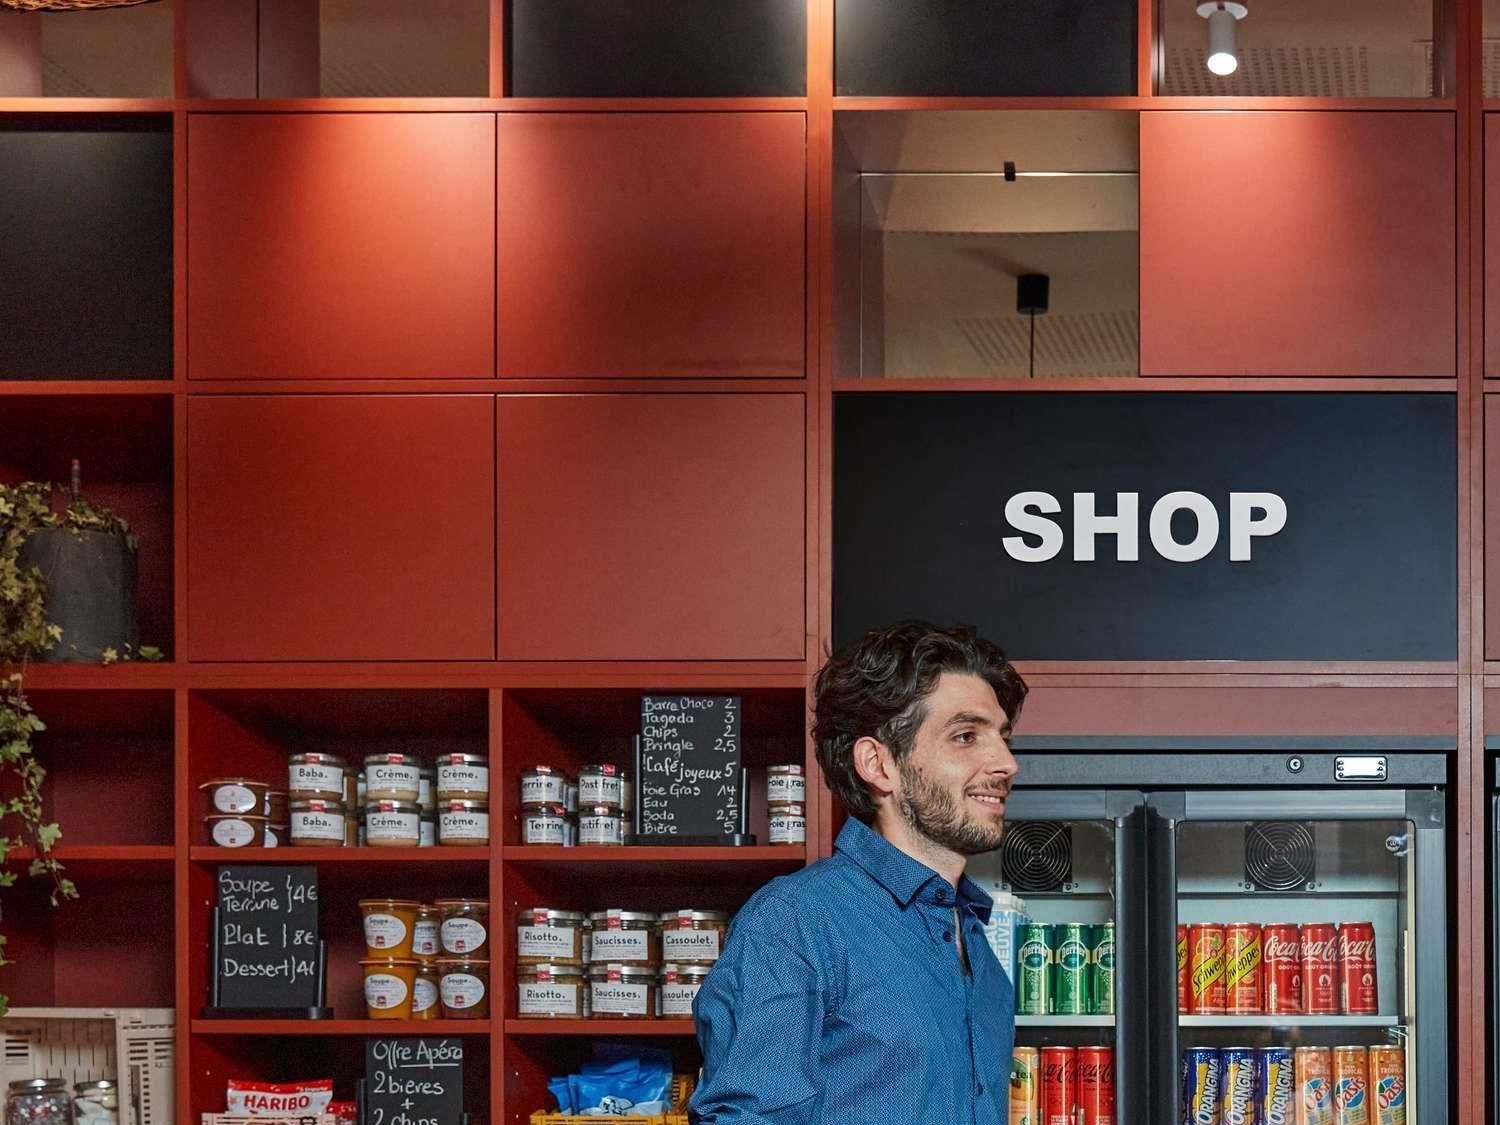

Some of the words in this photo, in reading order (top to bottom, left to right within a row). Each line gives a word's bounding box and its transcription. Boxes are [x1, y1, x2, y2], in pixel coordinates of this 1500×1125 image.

[1002, 491, 1288, 562] SHOP
[643, 697, 680, 712] Barre
[680, 697, 714, 710] Choco
[724, 698, 737, 709] 2
[724, 711, 735, 724] 3
[643, 726, 678, 741] Chips
[723, 725, 736, 737] 2
[643, 737, 695, 759] Pringle
[714, 738, 736, 752] 2,5
[299, 768, 328, 779] Baba.
[376, 768, 414, 780] Crème.
[442, 768, 478, 780] Crème.
[647, 756, 680, 776] Café
[675, 763, 722, 783] joyeux
[724, 762, 737, 777] 5
[669, 783, 701, 798] Gras
[717, 785, 736, 797] 14
[643, 797, 668, 808] Eau
[726, 797, 738, 808] 2
[302, 816, 331, 827] Baba.
[371, 816, 408, 827] Crème.
[443, 816, 479, 827] Crème.
[643, 810, 674, 822] Soda
[716, 810, 738, 821] 2,5
[529, 820, 561, 831] Terrin
[644, 822, 677, 834] Bière
[724, 822, 735, 834] 5
[219, 870, 274, 899] Soupe
[293, 884, 318, 904] 4€
[223, 895, 279, 912] Terrine
[223, 923, 270, 945] Plat
[293, 929, 315, 945] 8€
[525, 931, 562, 942] Risotto.
[594, 936, 641, 945] Saucisses.
[665, 935, 713, 945] Cassoulet.
[223, 958, 289, 978] Dessert
[527, 989, 566, 999] Risotto.
[594, 988, 640, 999] Saucisses.
[373, 1040, 413, 1070] Offre
[373, 1071, 386, 1093] 2
[1195, 1058, 1219, 1124] ORANGINA
[1227, 1058, 1253, 1125] ORANGINA
[1268, 1058, 1293, 1125] ORANGINA
[243, 1095, 311, 1111] HARIBO
